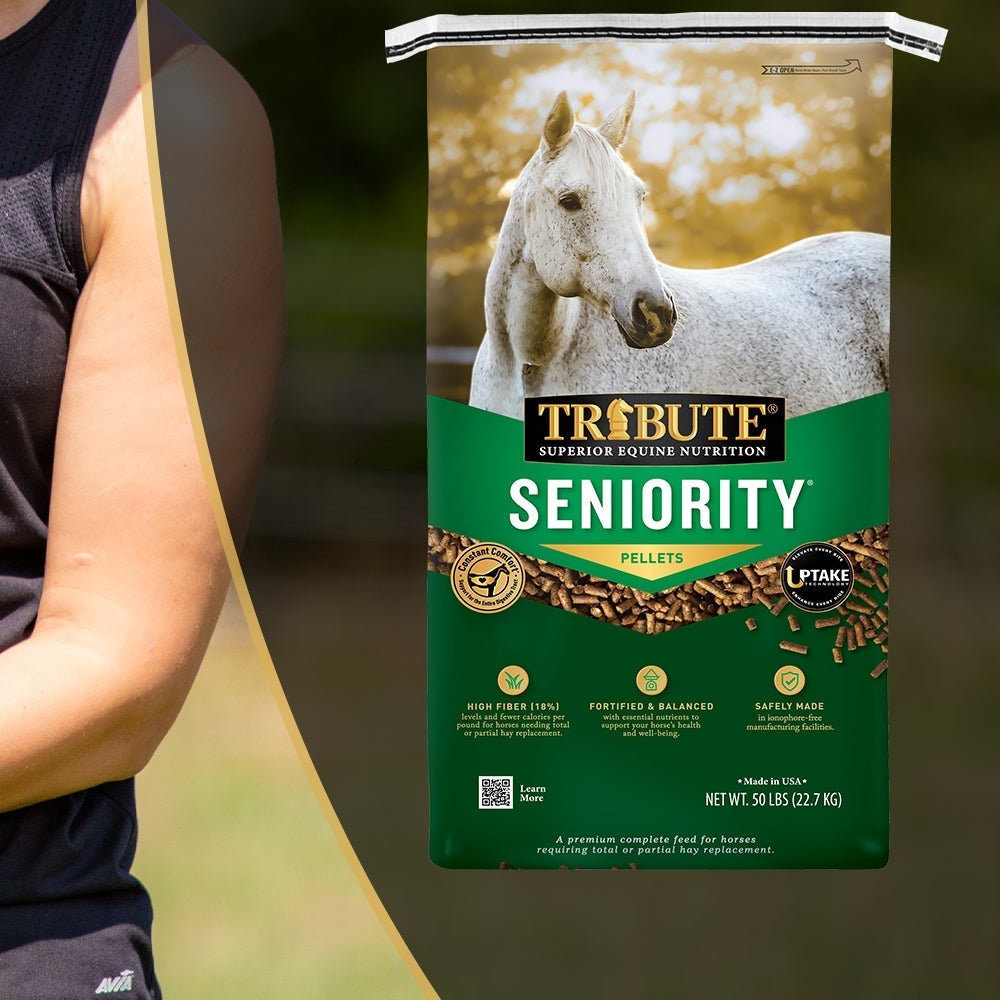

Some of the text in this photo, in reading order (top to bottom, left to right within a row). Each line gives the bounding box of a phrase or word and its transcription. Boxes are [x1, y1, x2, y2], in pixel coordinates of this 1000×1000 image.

[539, 446, 766, 458] SUPERIOR EQUINE NUTRITION
[458, 547, 519, 573] Constant Comfort
[620, 552, 684, 564] PELLETS
[785, 565, 850, 588] UPTAKE
[467, 702, 560, 711] HIGH FIBER (18%)
[589, 702, 714, 710] FORTIFIED & BALANCED
[755, 702, 824, 710] SAFELY MADE
[552, 714, 565, 722] per
[767, 713, 823, 723] ionophore-free
[456, 721, 481, 730] pound
[521, 721, 551, 730] needing
[601, 721, 701, 731] support your horse's health
[746, 723, 835, 733] manufacturing facilities.
[474, 729, 499, 738] partial
[500, 729, 514, 738] hay
[515, 729, 563, 738] replacement.
[638, 730, 681, 739] well-being.
[743, 777, 802, 786] Made in USA
[519, 784, 547, 793] Learn
[519, 793, 544, 802] More
[705, 792, 842, 808] NET WT. 50 LBS (22.7 KG)
[555, 834, 756, 845] A premium complete feed for horses
[536, 845, 589, 856] requiring
[592, 845, 618, 854] total
[637, 845, 676, 856] partial
[679, 845, 699, 856] hay
[703, 845, 775, 856] replacement.
